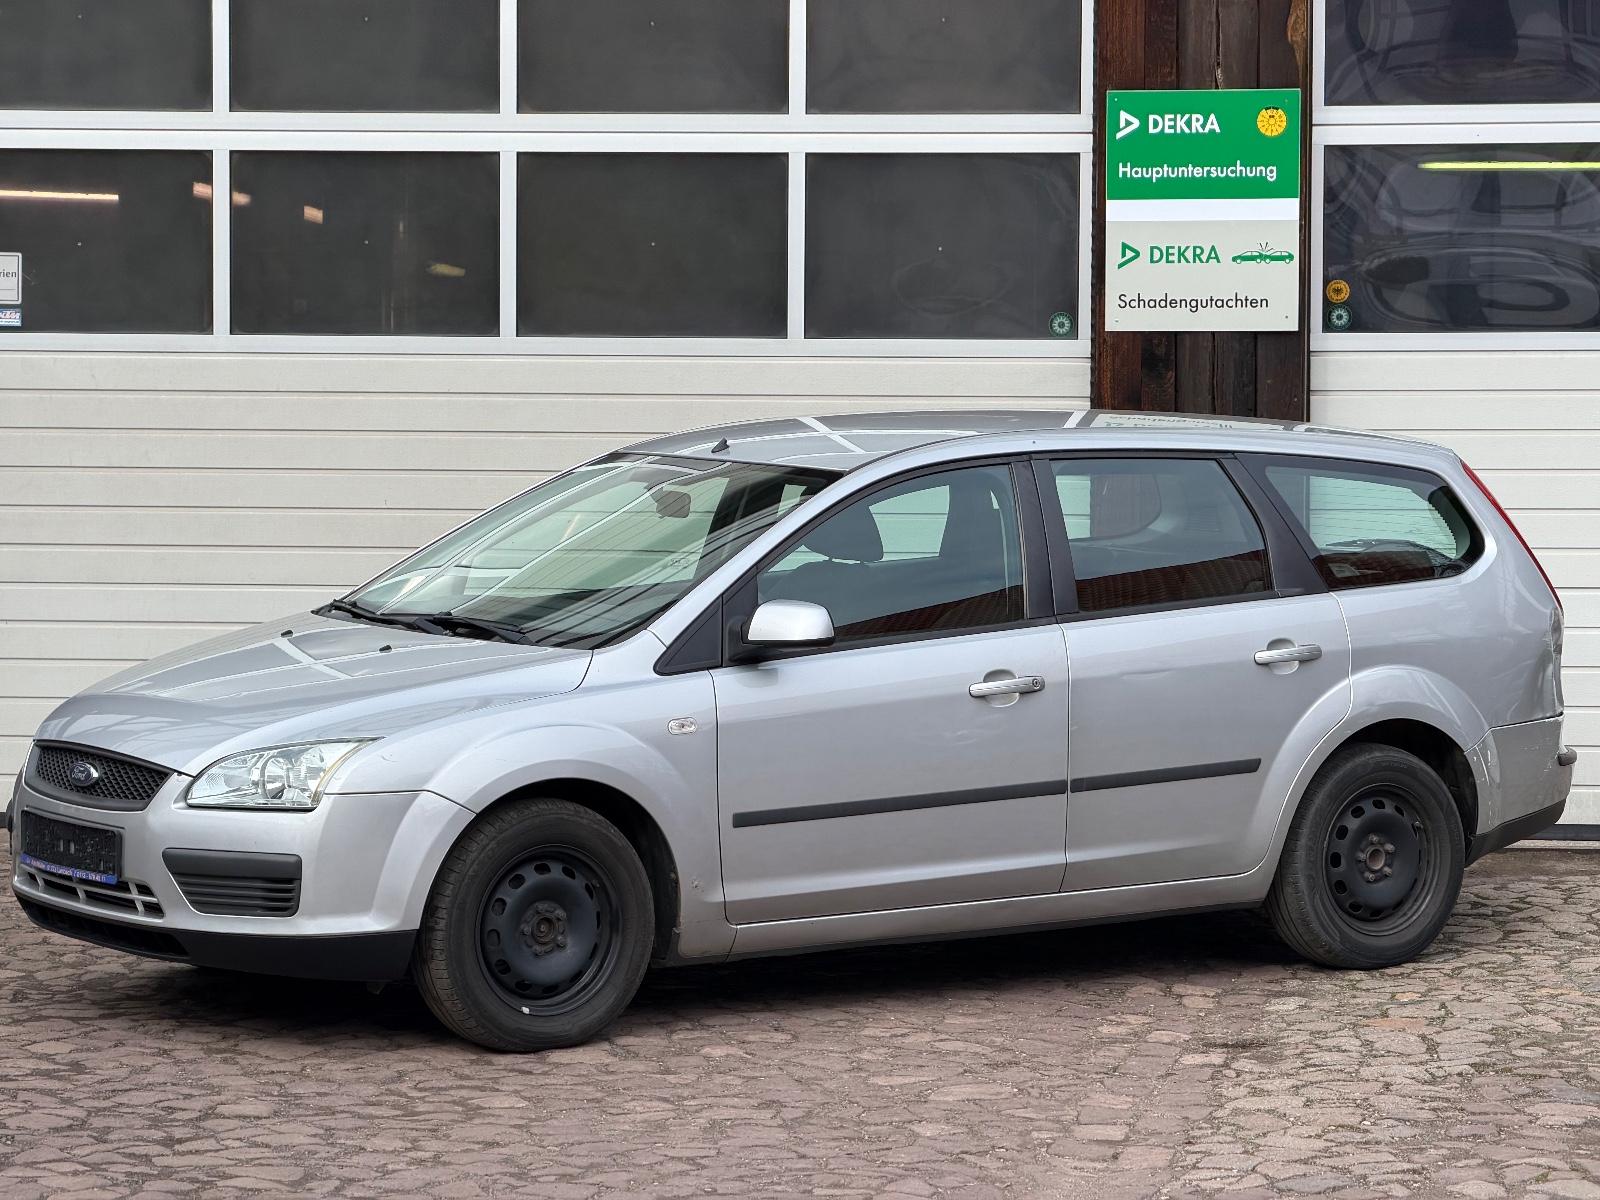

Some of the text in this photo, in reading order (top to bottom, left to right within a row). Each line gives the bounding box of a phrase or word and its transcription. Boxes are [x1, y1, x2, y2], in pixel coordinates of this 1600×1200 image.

[1148, 113, 1221, 134] DEKRA
[1118, 160, 1277, 182] Hauptuntersuchung
[1149, 245, 1221, 265] DEKRA
[1117, 292, 1269, 313] Schadengutachten
